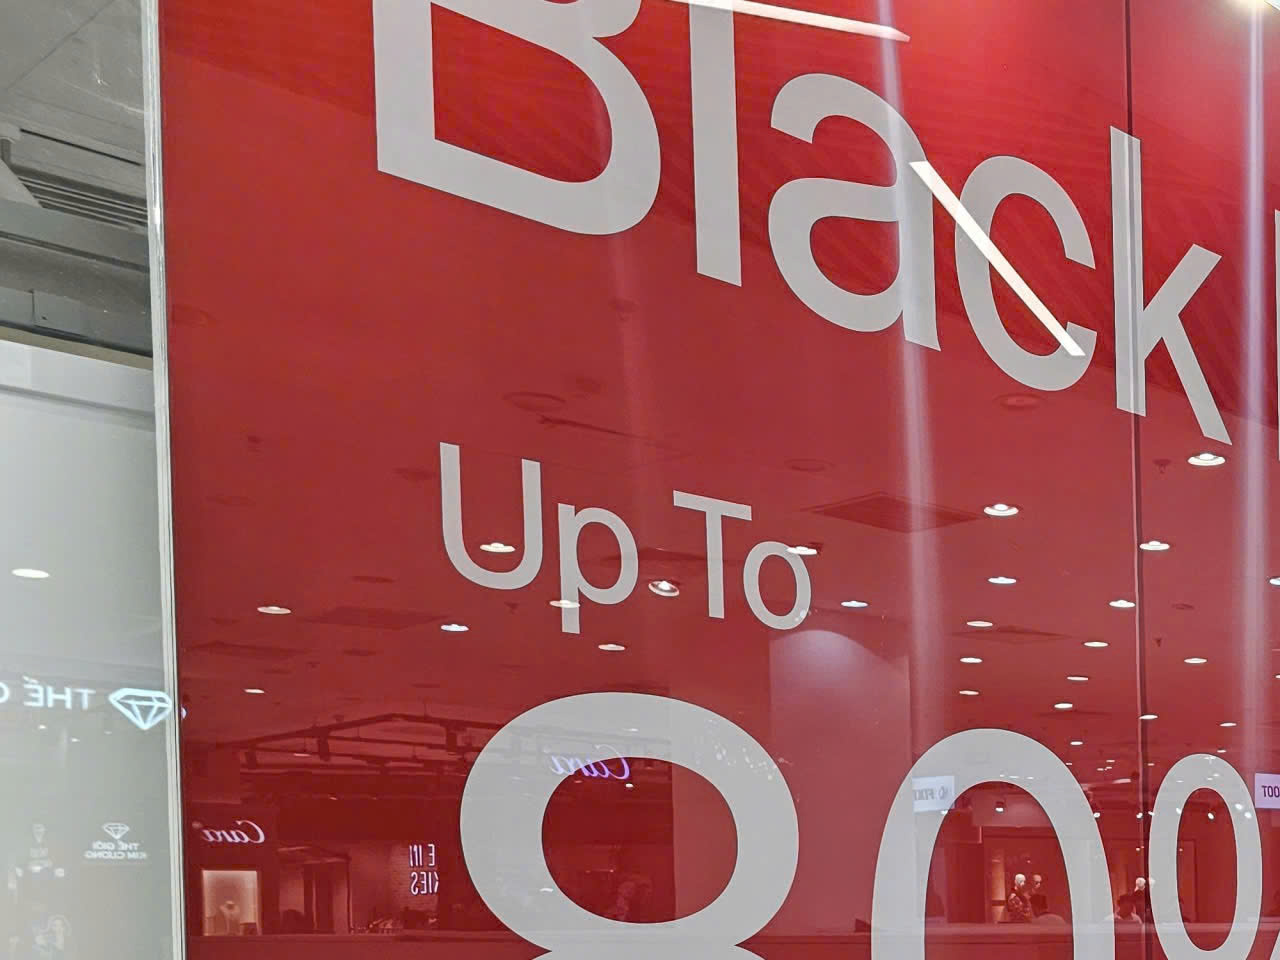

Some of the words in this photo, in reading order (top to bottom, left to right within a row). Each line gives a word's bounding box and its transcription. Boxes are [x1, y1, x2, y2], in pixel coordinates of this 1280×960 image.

[373, 0, 1231, 445] Black
[440, 442, 639, 634] Up
[673, 491, 812, 631] To
